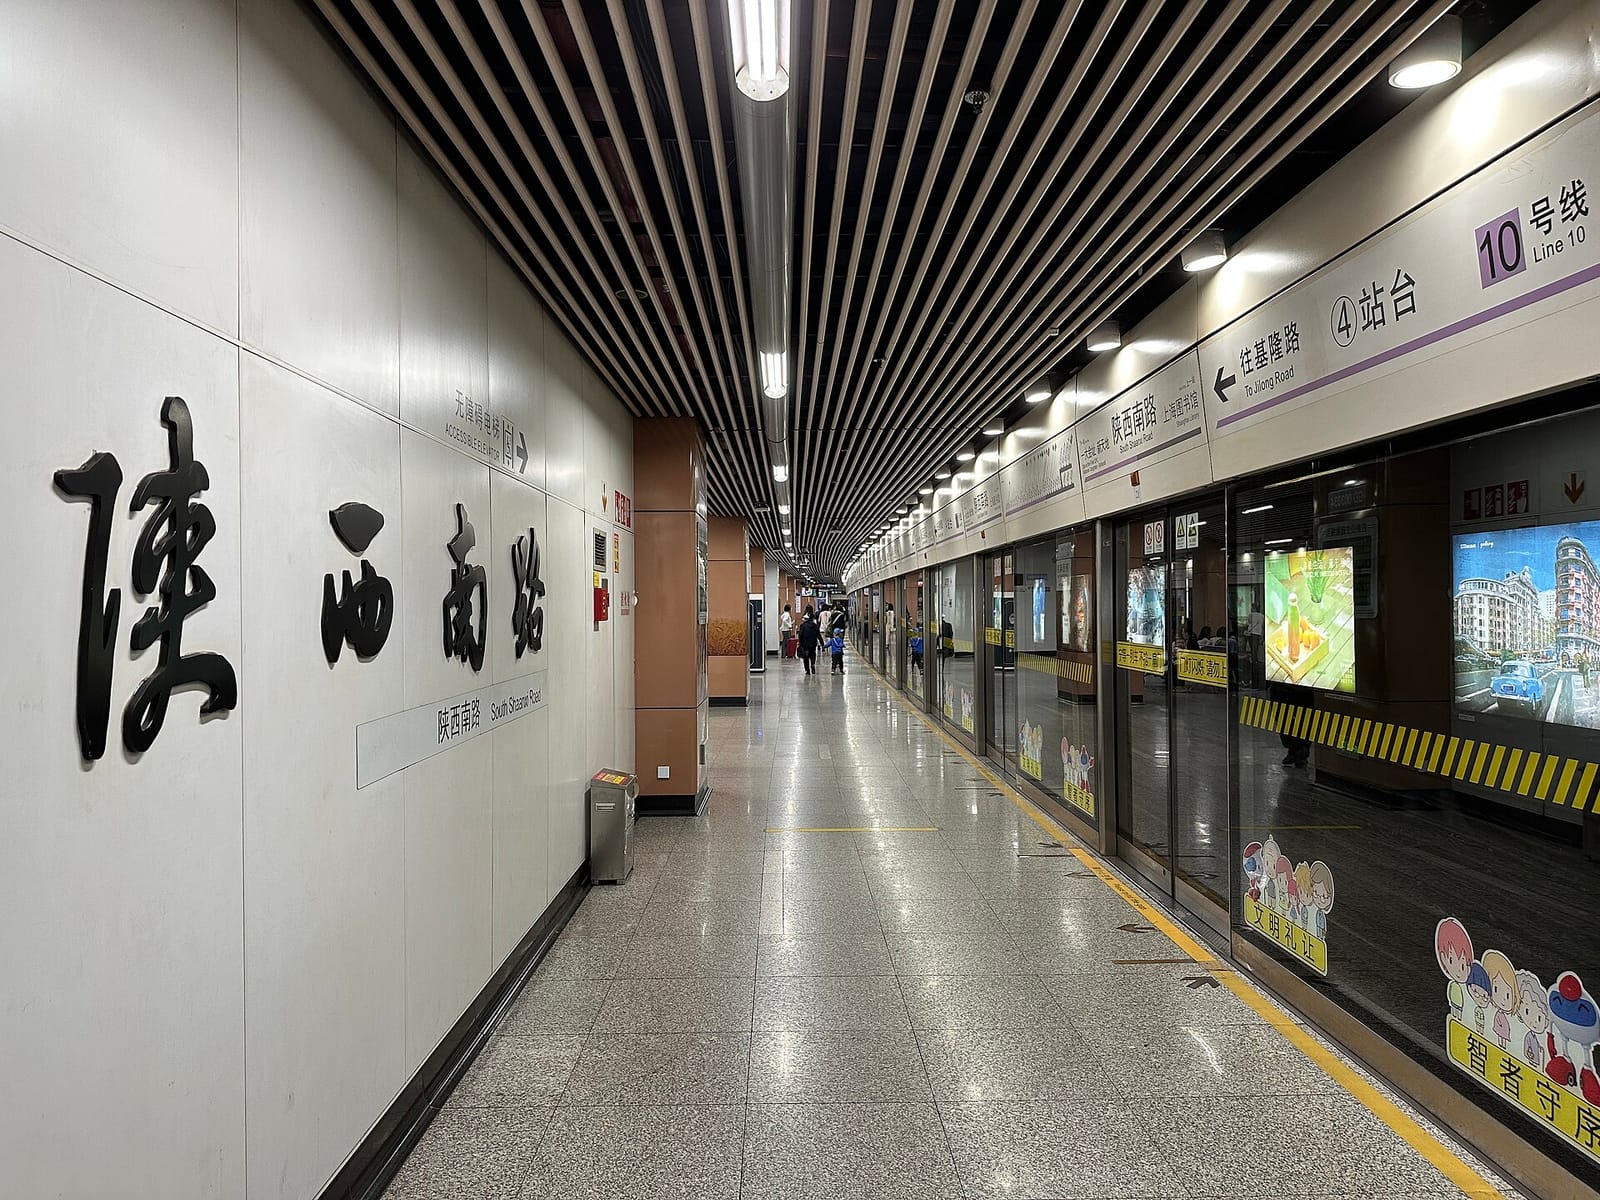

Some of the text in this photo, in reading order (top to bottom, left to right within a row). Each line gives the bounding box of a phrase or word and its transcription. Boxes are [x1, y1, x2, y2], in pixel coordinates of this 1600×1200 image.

[1480, 179, 1589, 279] 10 号线
[1533, 225, 1586, 263] Line 10
[1239, 320, 1300, 377] 往基隆路
[1163, 390, 1199, 424] 上海图书馆
[1244, 365, 1295, 397] To Jilong Road
[455, 388, 501, 440] 无障碍电梯
[1111, 392, 1157, 446] 陕西南路
[437, 697, 481, 744] 陕西南路
[490, 687, 542, 721] South Shaanxi Road
[1253, 904, 1315, 963] 文明礼让
[1467, 1032, 1600, 1148] 智者守序
